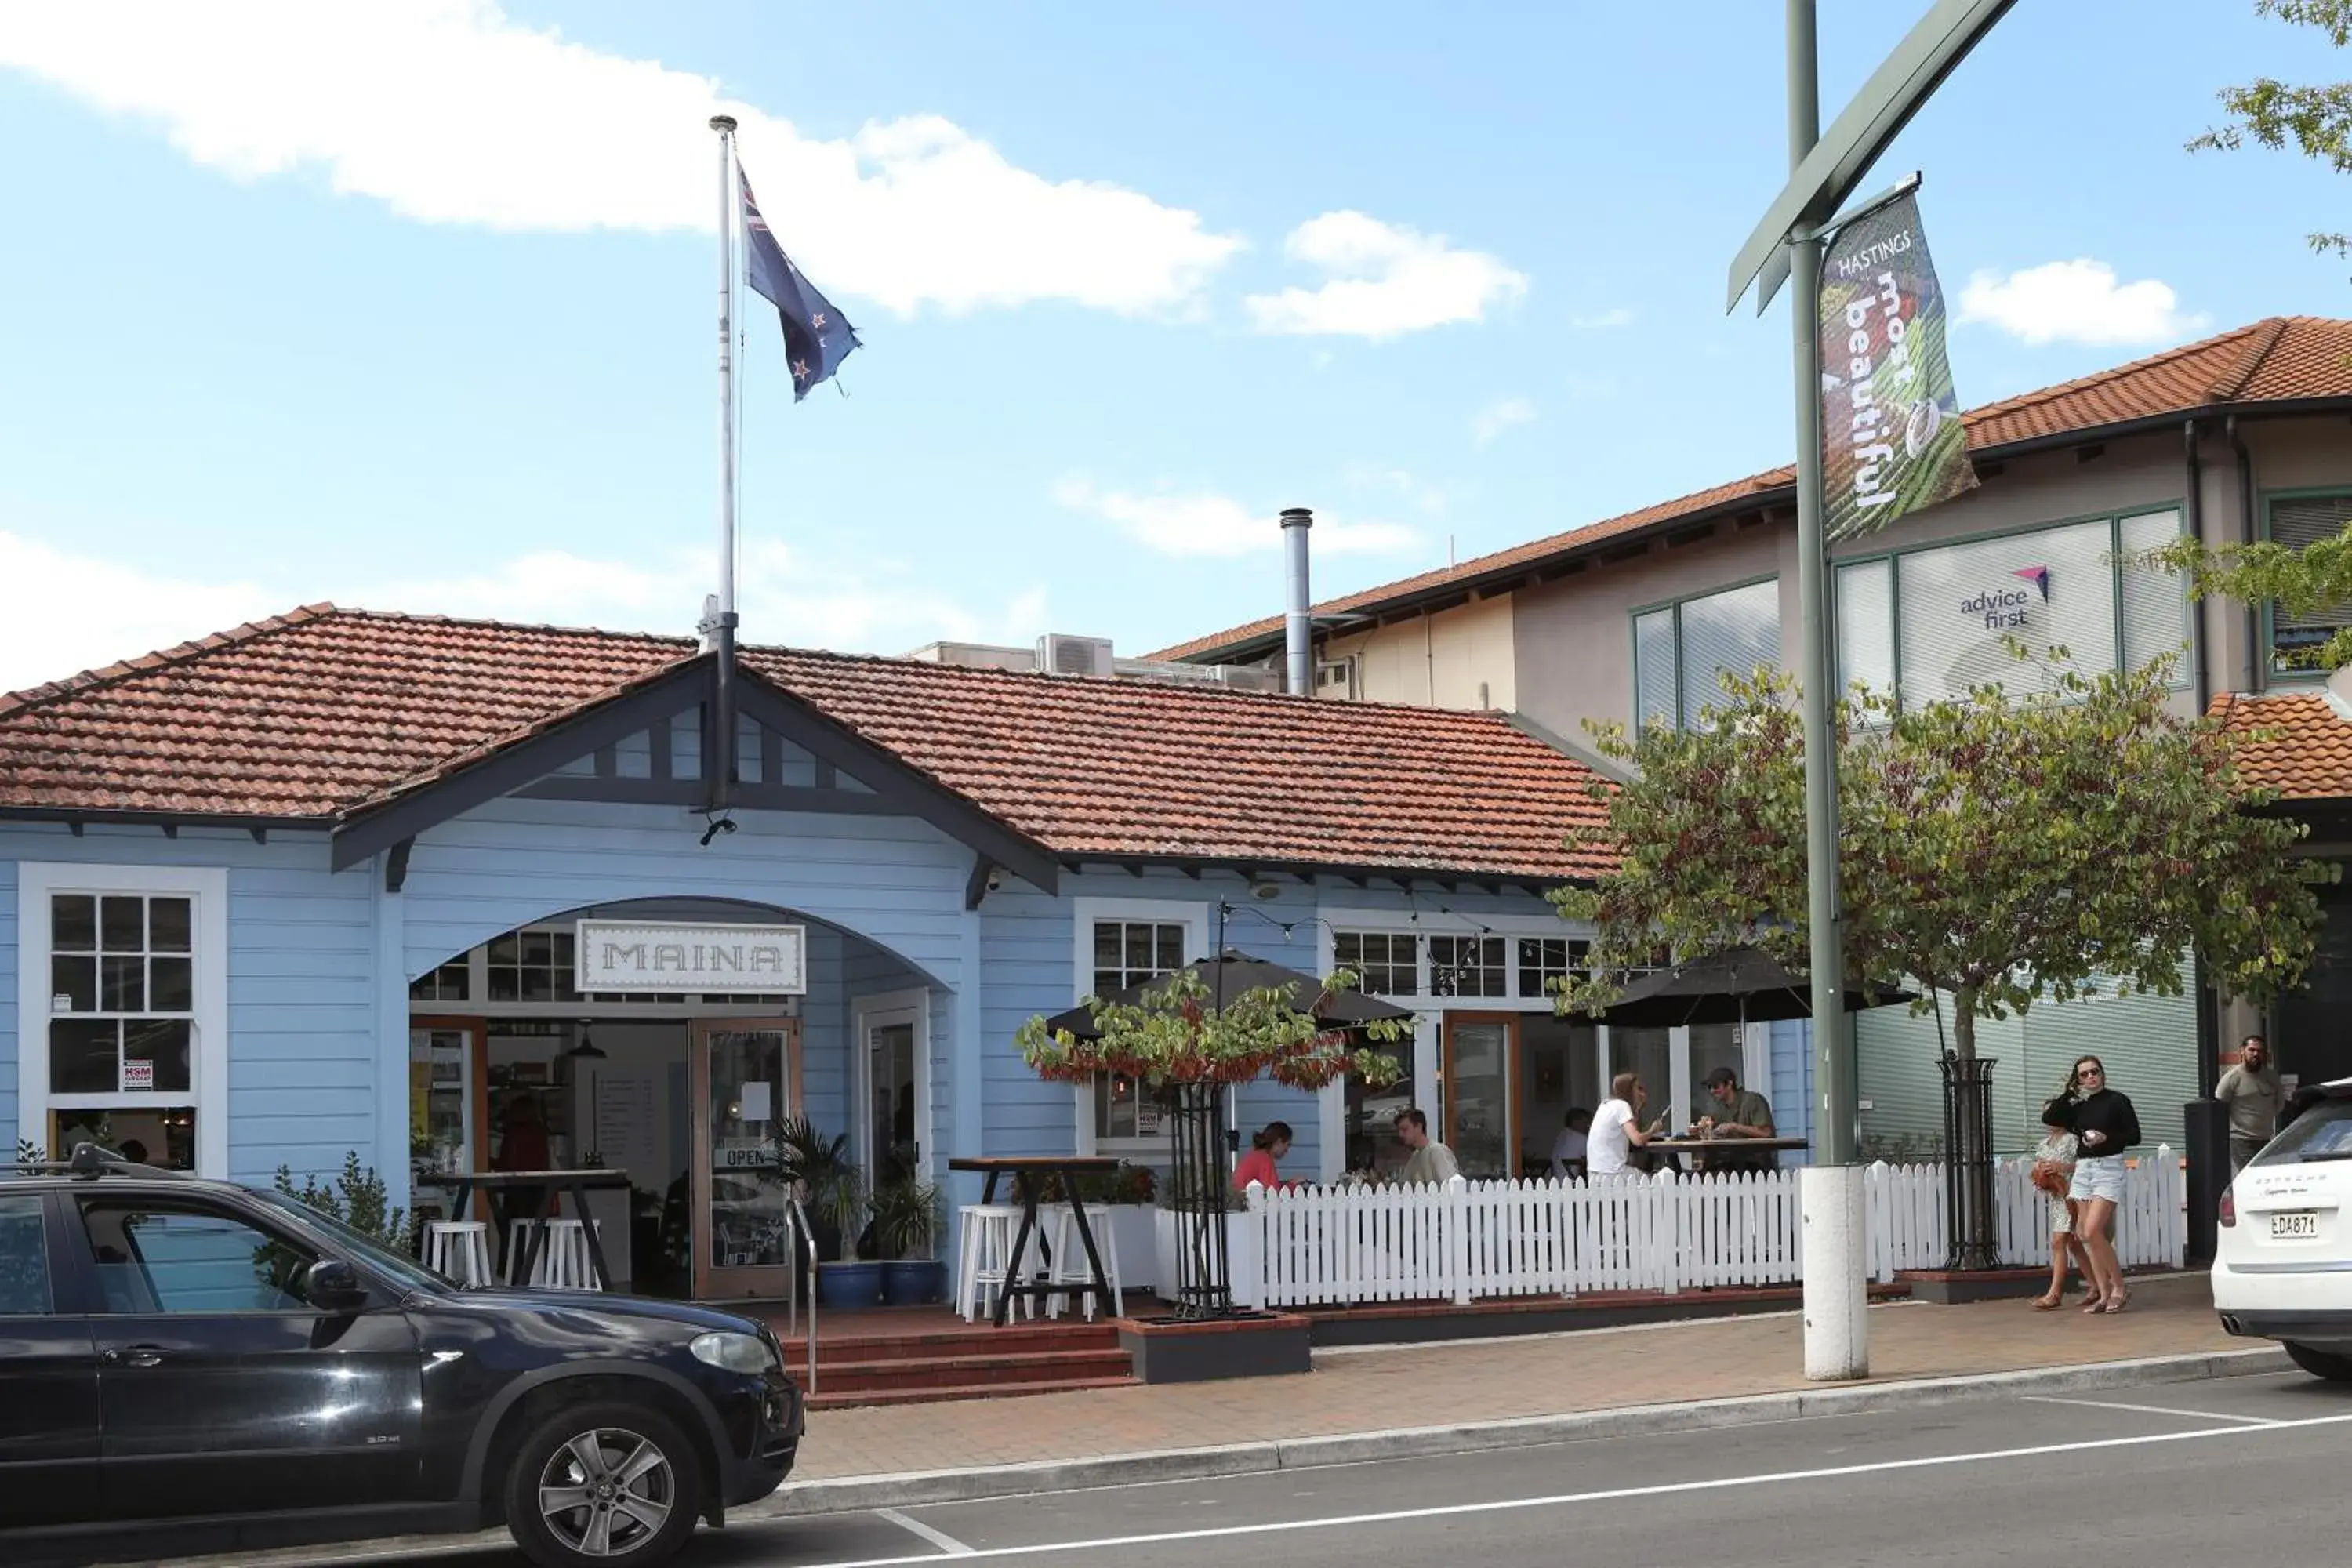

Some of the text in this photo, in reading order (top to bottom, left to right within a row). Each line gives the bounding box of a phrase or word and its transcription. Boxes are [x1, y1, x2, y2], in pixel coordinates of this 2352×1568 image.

[1838, 230, 1911, 277] HASTINGS
[1878, 271, 1915, 386] most
[1846, 296, 1896, 506] beautiful
[1961, 590, 2027, 613] advice
[1984, 609, 2027, 630] first
[602, 943, 783, 972] MAINA
[125, 1067, 151, 1076] HSM
[727, 1149, 765, 1166] OPEN
